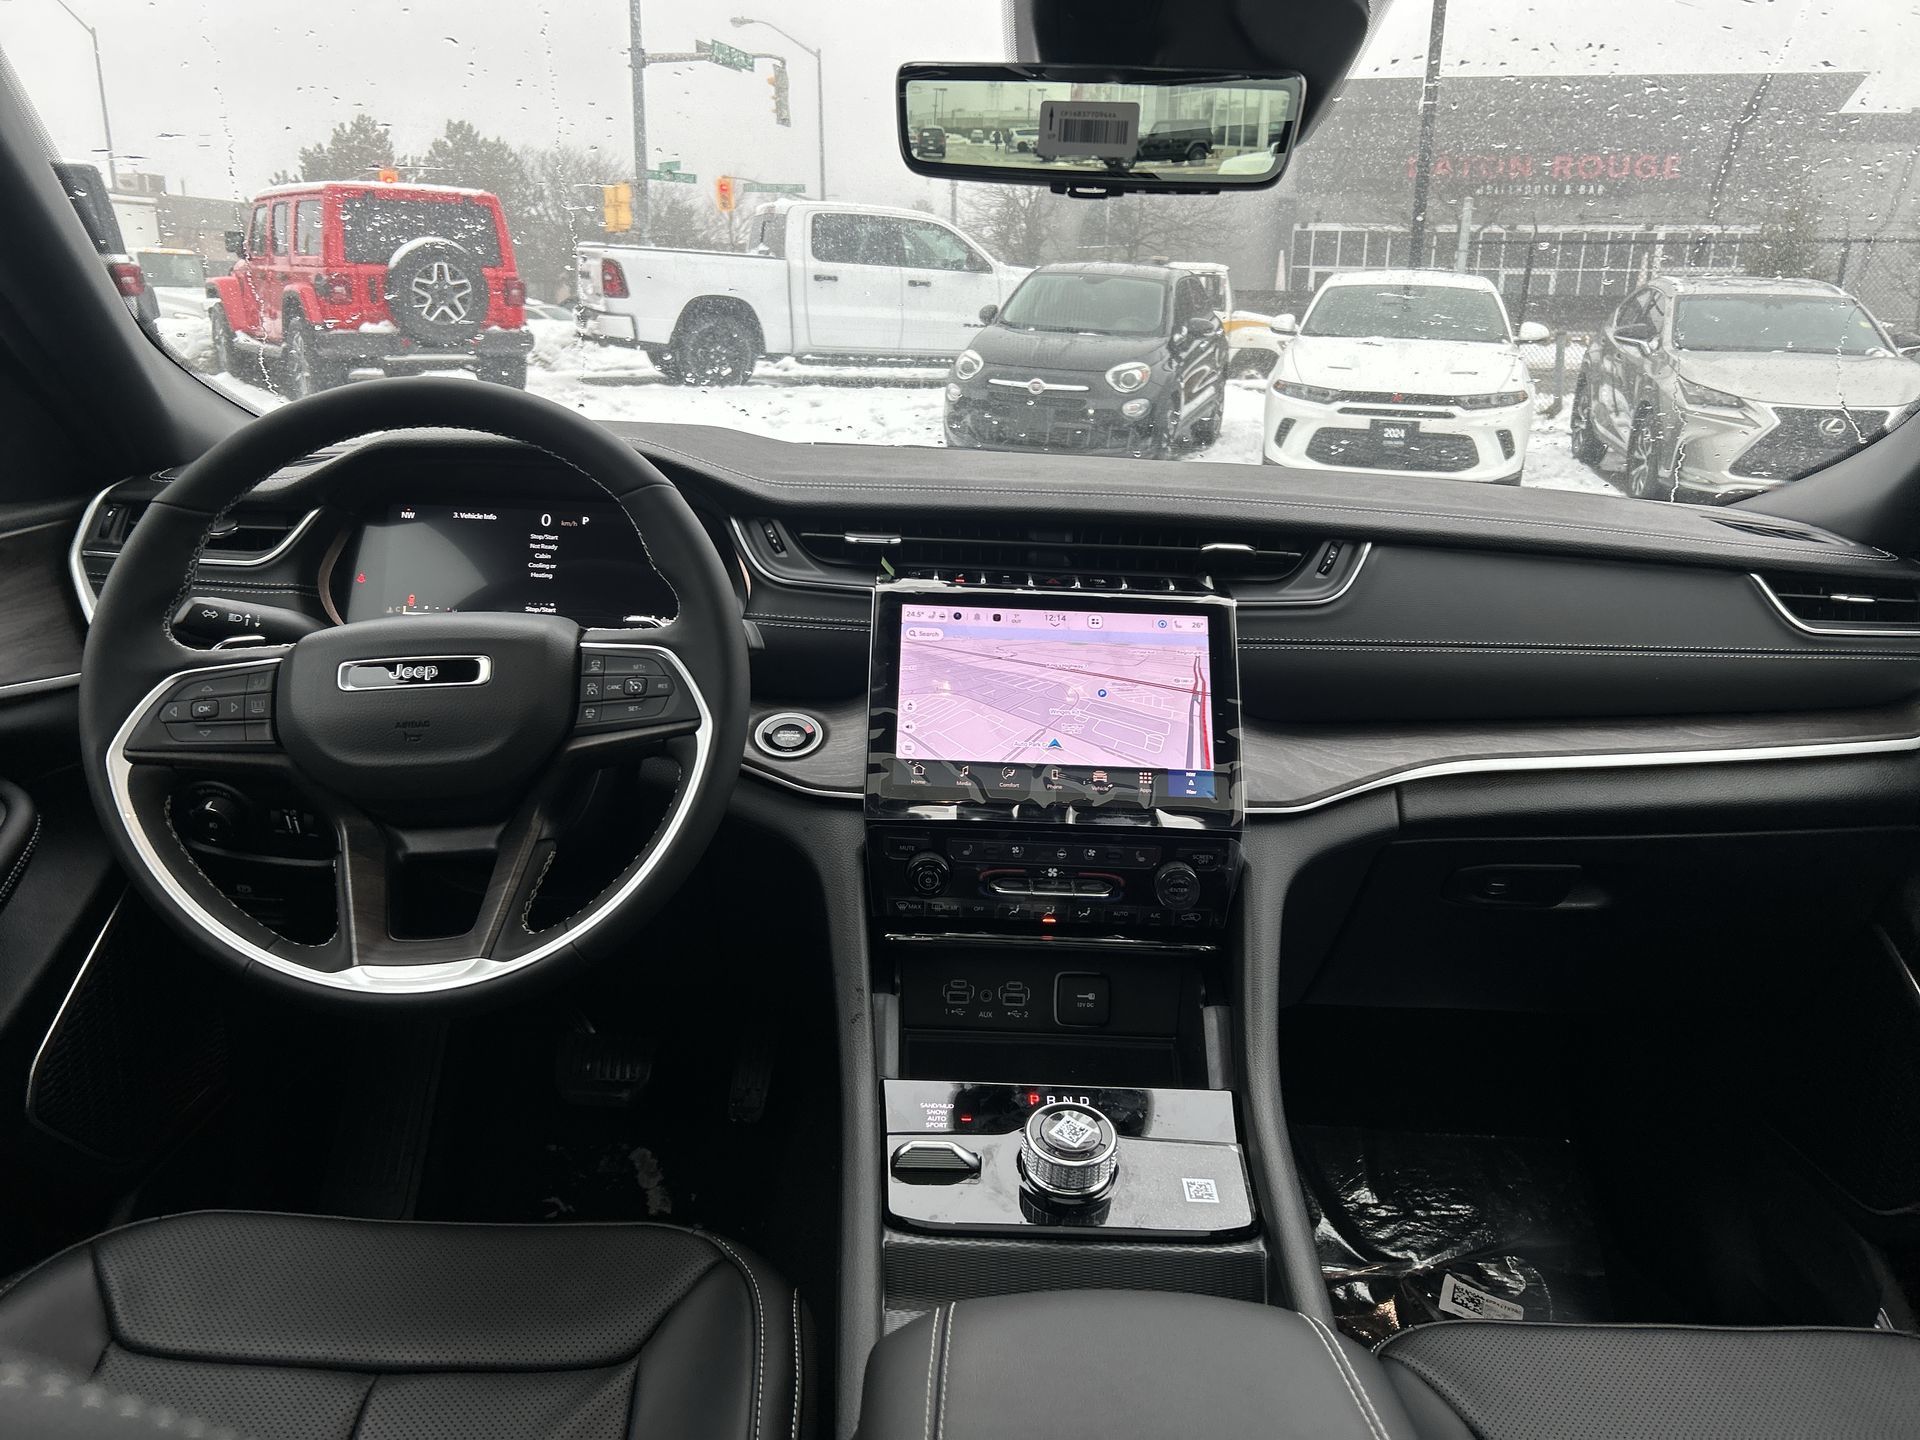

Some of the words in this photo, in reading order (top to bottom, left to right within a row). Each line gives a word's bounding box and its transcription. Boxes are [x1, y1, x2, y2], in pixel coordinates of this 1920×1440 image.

[1551, 154, 1681, 180] ROUGE
[1383, 427, 1405, 438] 2024
[401, 511, 416, 519] NW
[460, 512, 483, 520] Vehicle
[484, 513, 498, 521] Info
[541, 513, 551, 527] 0
[582, 516, 590, 525] P
[530, 533, 558, 541] Stop/Start
[541, 543, 558, 551] Ready
[528, 562, 550, 570] Cooling
[530, 572, 553, 580] Heating
[1045, 614, 1067, 622] 12:14
[919, 630, 939, 638] Search
[388, 664, 439, 680] Jeep
[198, 704, 211, 713] OK
[394, 720, 430, 729] AIRBAG
[1030, 1094, 1040, 1105] P
[1046, 1095, 1056, 1105] R
[1063, 1095, 1073, 1103] N
[1080, 1096, 1090, 1106] D
